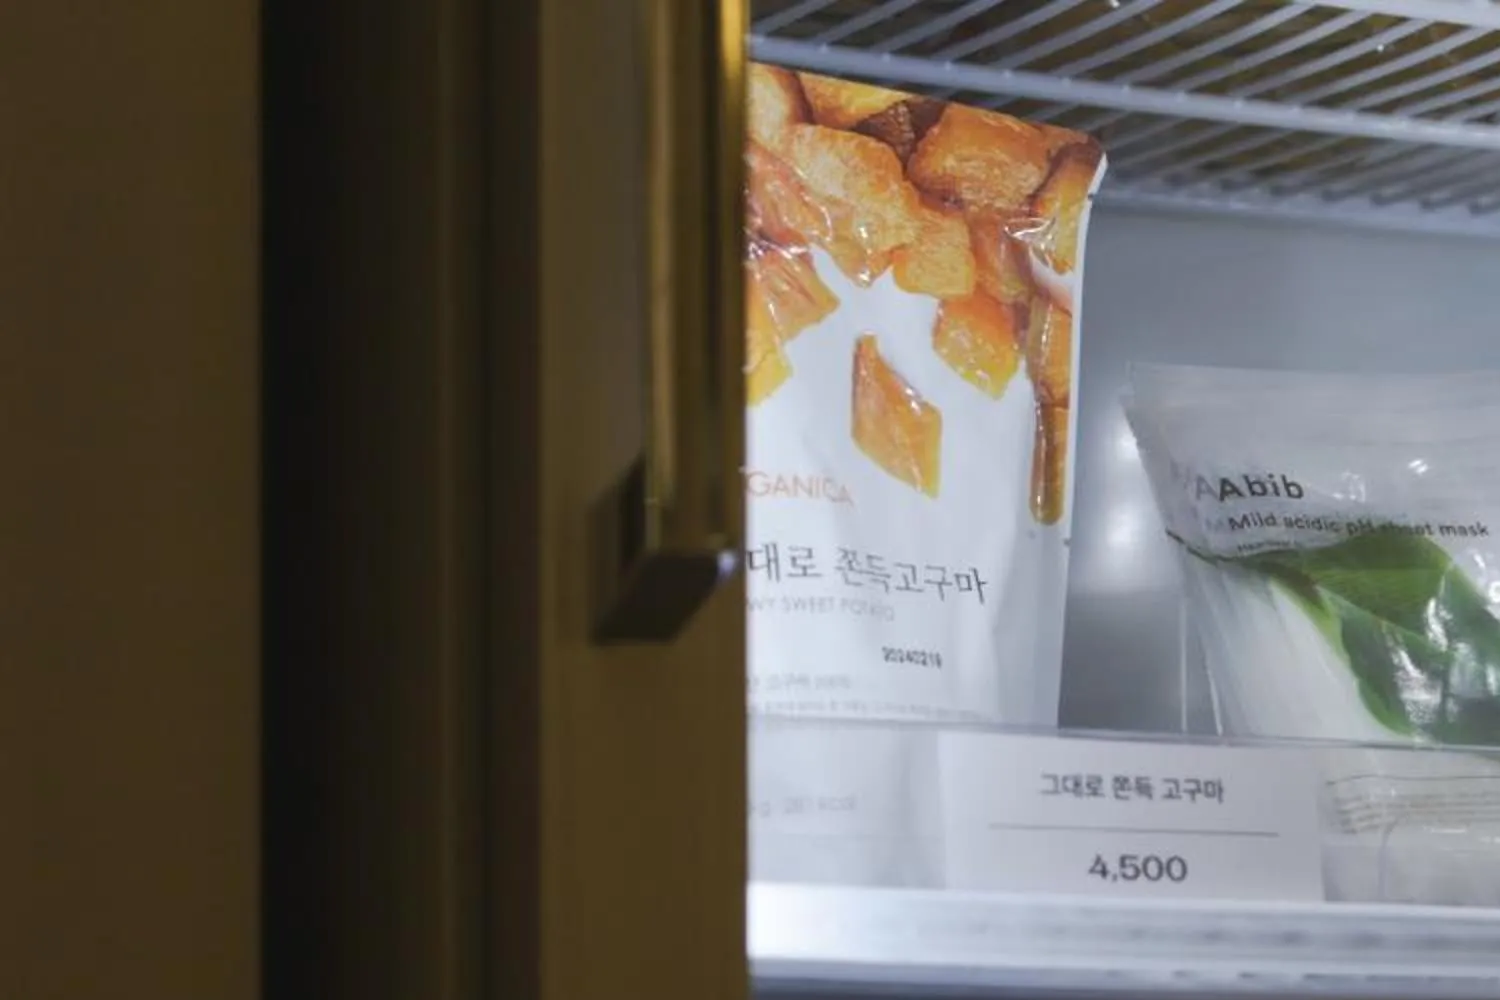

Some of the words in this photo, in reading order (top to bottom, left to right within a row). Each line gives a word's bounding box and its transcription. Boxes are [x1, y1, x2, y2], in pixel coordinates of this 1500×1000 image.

[1219, 472, 1304, 503] Abib
[1228, 512, 1277, 532] Mild
[1282, 515, 1340, 533] acidic
[1438, 520, 1490, 538] mask
[1041, 774, 1105, 798] 그대로
[1112, 774, 1154, 800] 쫀득
[1162, 778, 1225, 804] 고구마
[1088, 854, 1188, 883] 4,500
